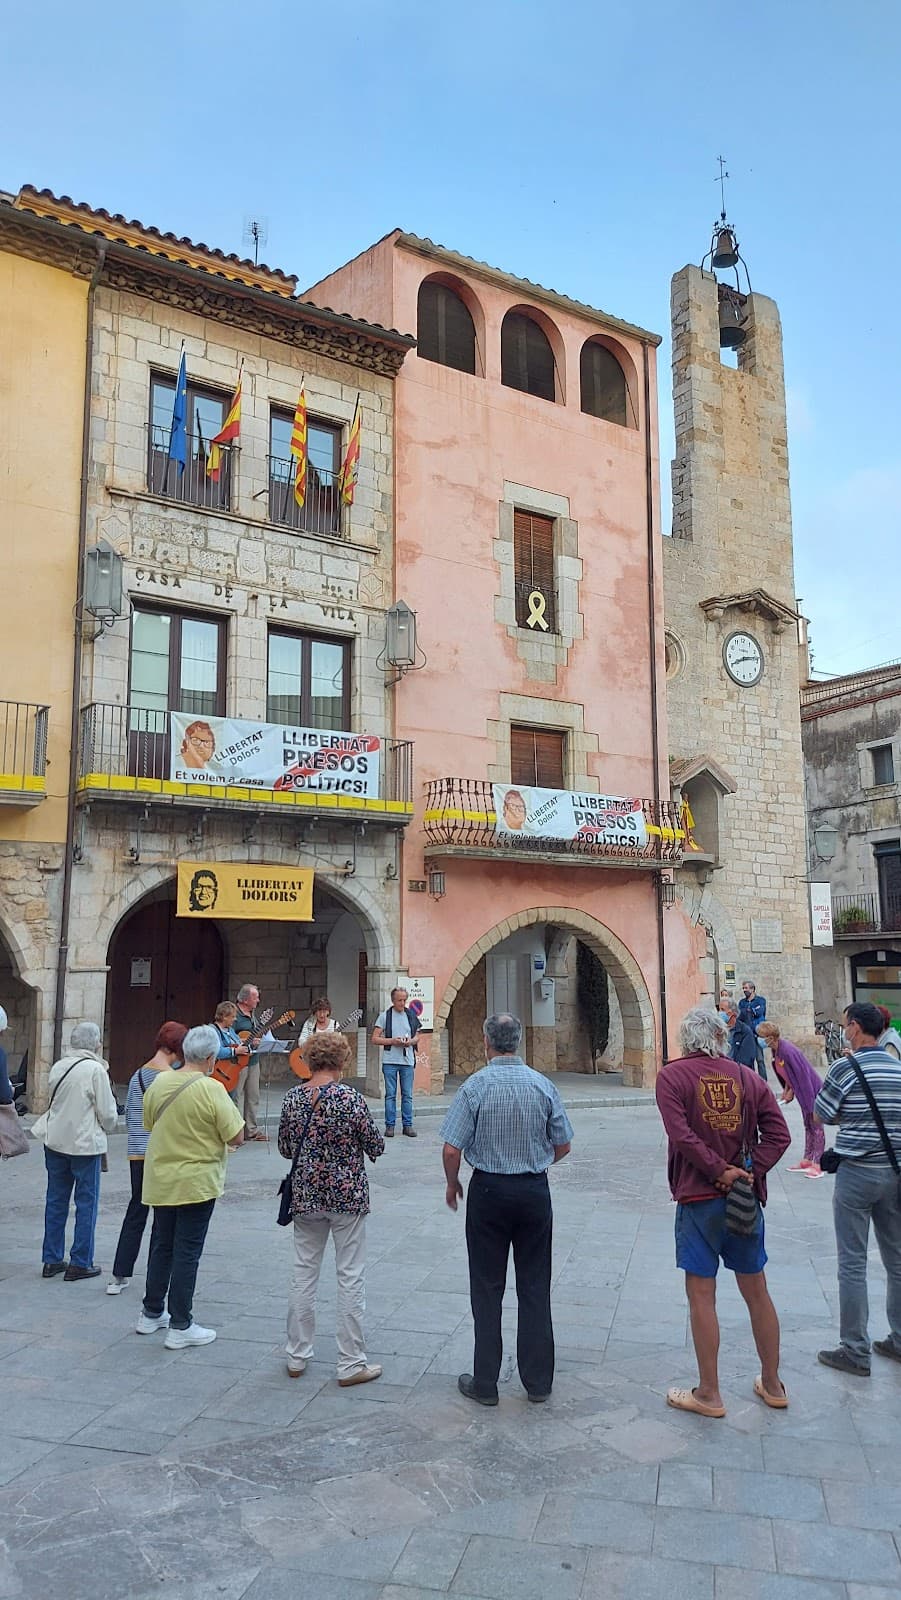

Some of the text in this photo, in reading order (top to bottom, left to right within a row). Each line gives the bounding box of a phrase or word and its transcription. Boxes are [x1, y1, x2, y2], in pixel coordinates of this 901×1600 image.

[135, 569, 355, 621] CASA DE LA VILA
[214, 730, 264, 762] LLIBERTAT
[282, 730, 370, 752] LLIBERTAT
[230, 746, 261, 766] Dolors
[282, 748, 369, 774] PRESOS
[175, 770, 188, 780] Et
[191, 772, 225, 783] volem
[281, 773, 368, 794] POLÍTICS!
[527, 796, 558, 824] LLIBERTAT
[571, 795, 634, 812] LLIBERTAT
[538, 809, 558, 826] Dolors
[574, 810, 637, 831] PRESOS
[577, 831, 640, 848] POLÍTICS!
[236, 878, 304, 891] LLIBERTAT
[241, 889, 298, 902] DOLORS
[707, 1082, 728, 1092] FUT
